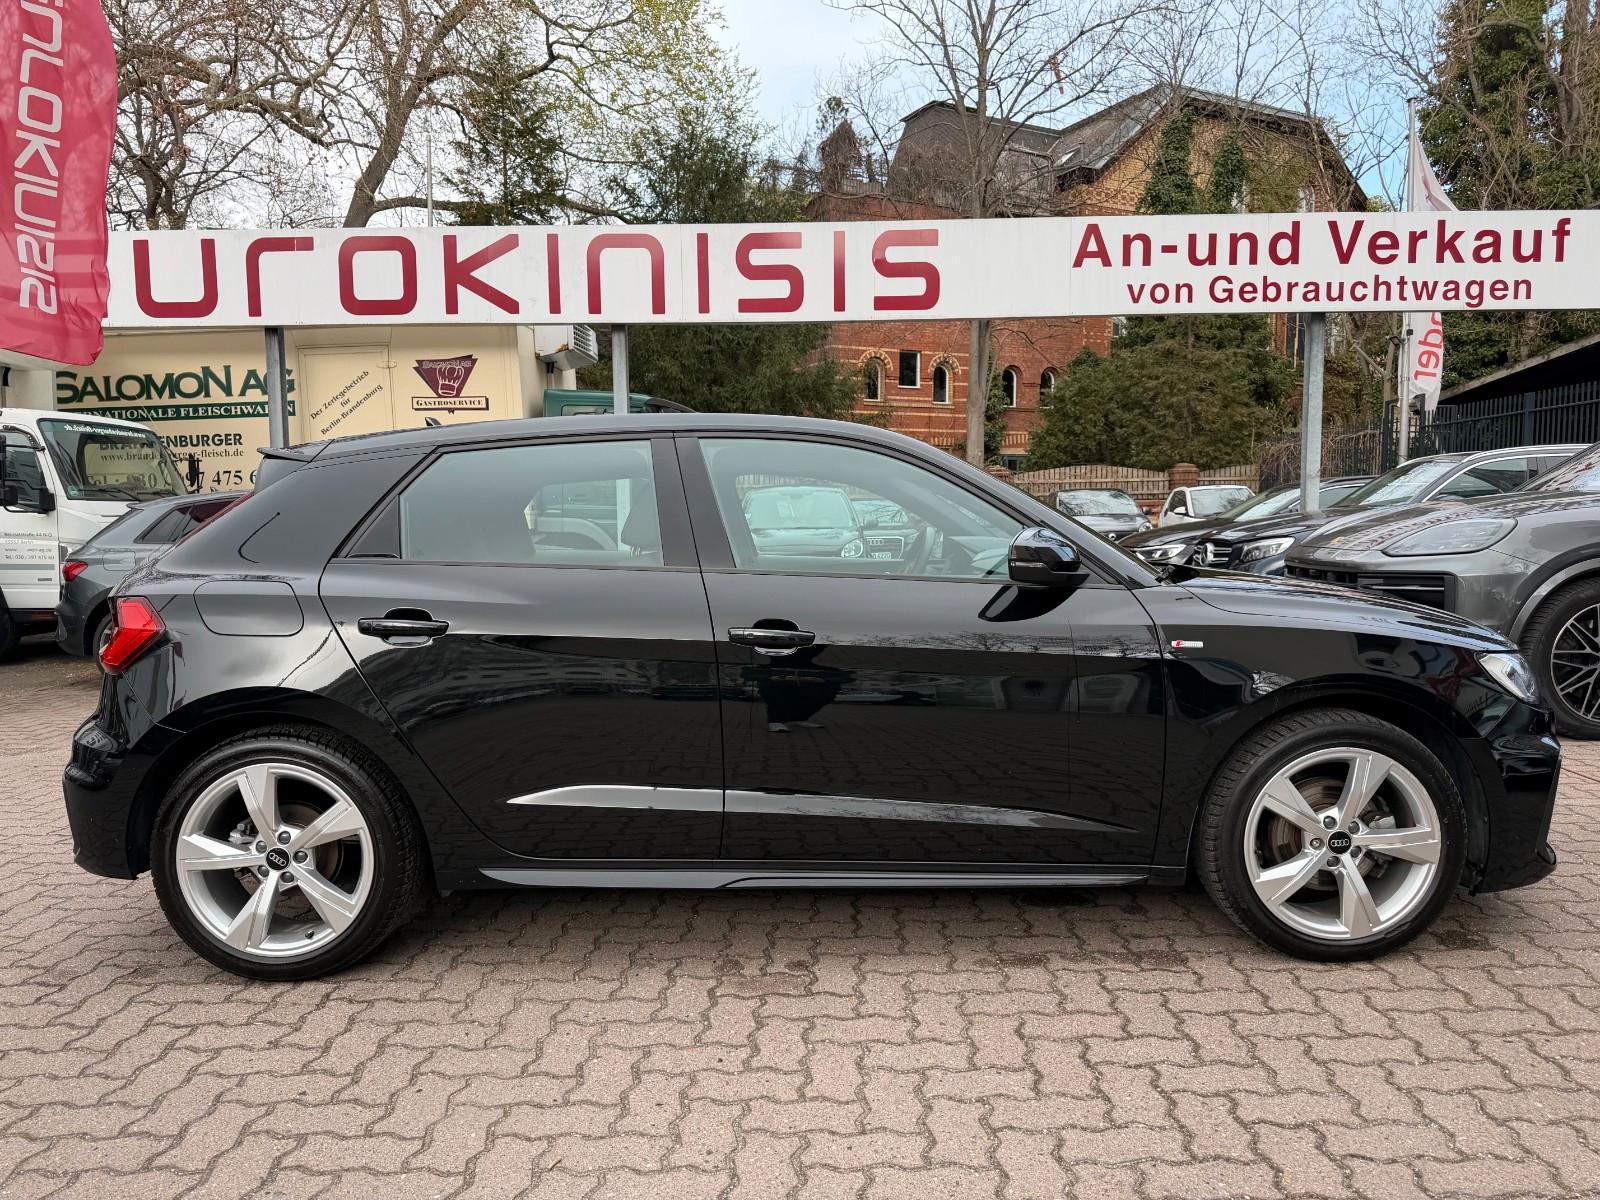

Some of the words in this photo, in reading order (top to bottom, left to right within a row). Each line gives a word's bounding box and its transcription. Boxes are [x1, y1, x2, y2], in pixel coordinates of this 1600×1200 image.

[1327, 217, 1571, 264] Verkauf
[1127, 282, 1193, 304] von
[1209, 274, 1532, 308] Gebrauchtwagen
[56, 364, 234, 404] SALOMON
[310, 407, 323, 420] Der
[340, 397, 351, 407] für
[212, 470, 243, 486] 475
